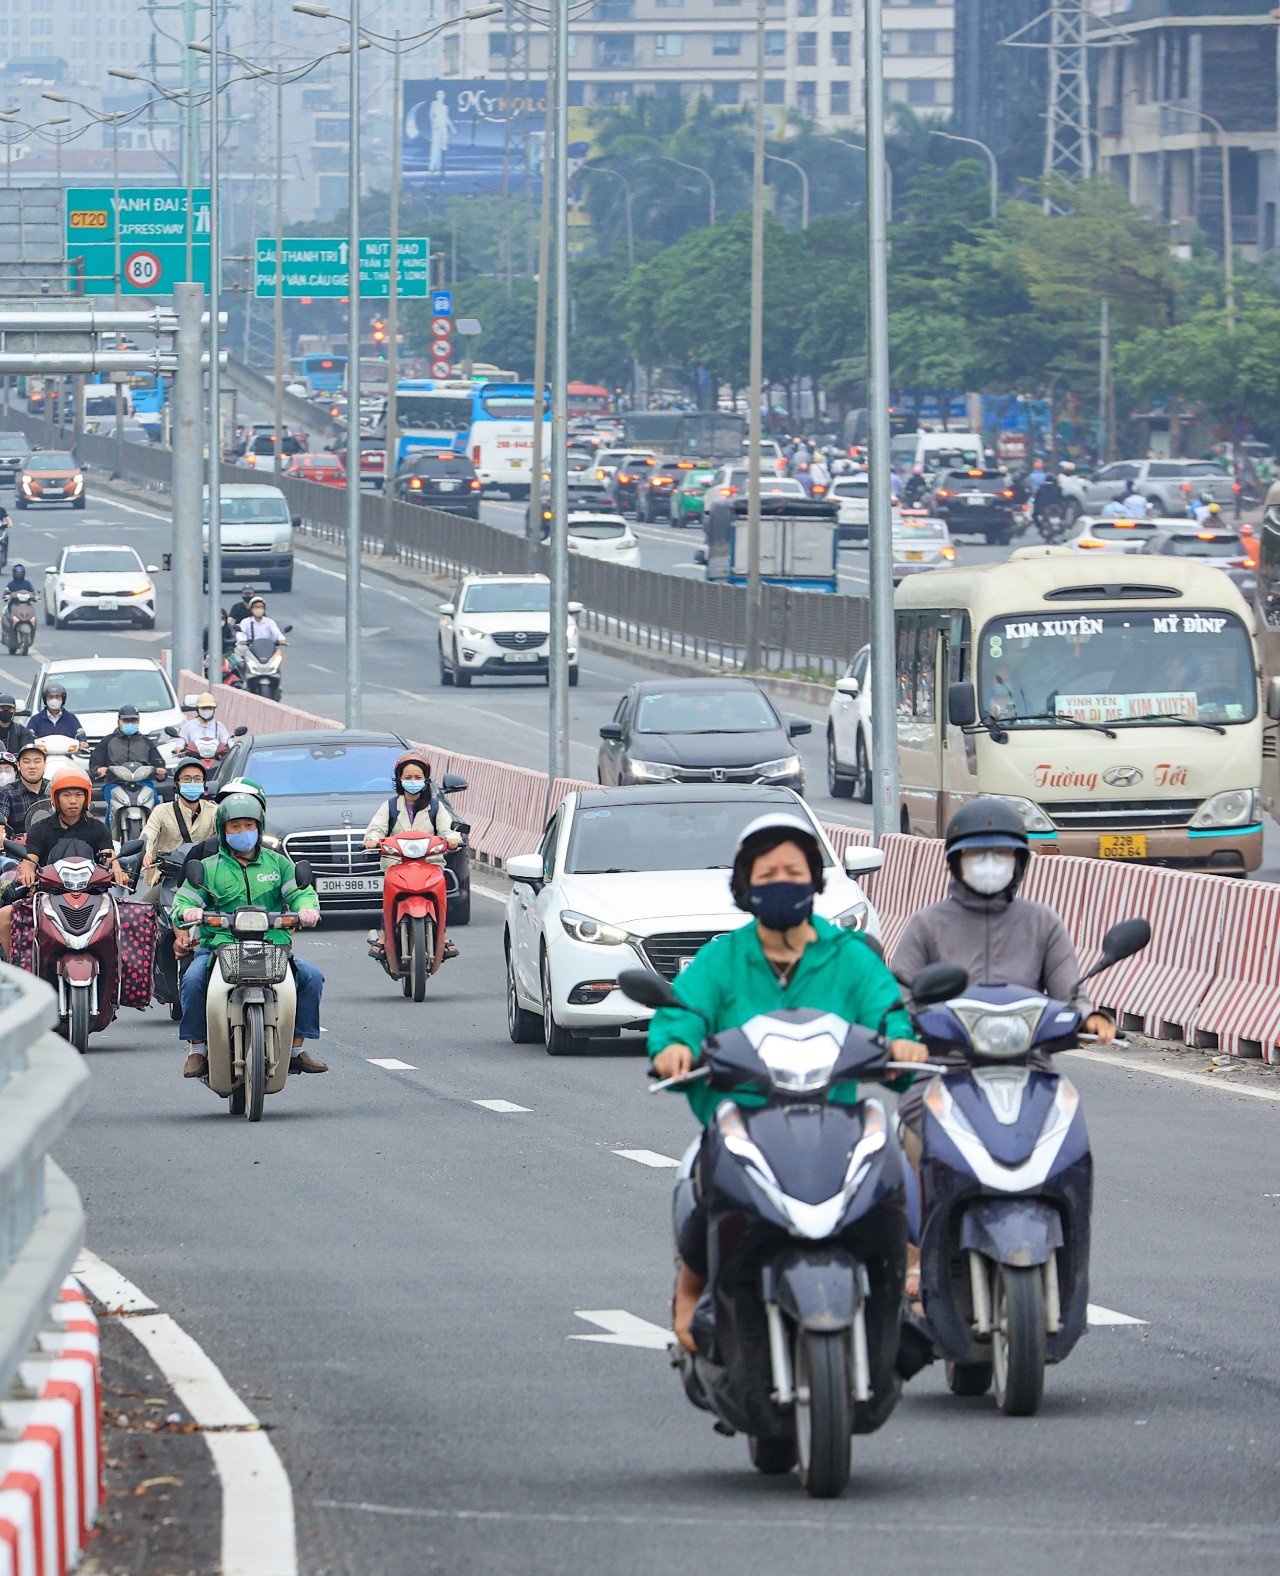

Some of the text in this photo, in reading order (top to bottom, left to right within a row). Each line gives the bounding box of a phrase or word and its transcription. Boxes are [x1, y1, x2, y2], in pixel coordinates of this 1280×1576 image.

[281, 250, 319, 262] THANH
[133, 261, 153, 277] 80
[1005, 622, 1039, 639] KIM
[1041, 616, 1104, 637] XUYÊN
[1153, 614, 1180, 633] MỸ
[1104, 846, 1141, 857] 002.64
[256, 871, 281, 883] Grab
[322, 880, 379, 891] 30H-988.15
